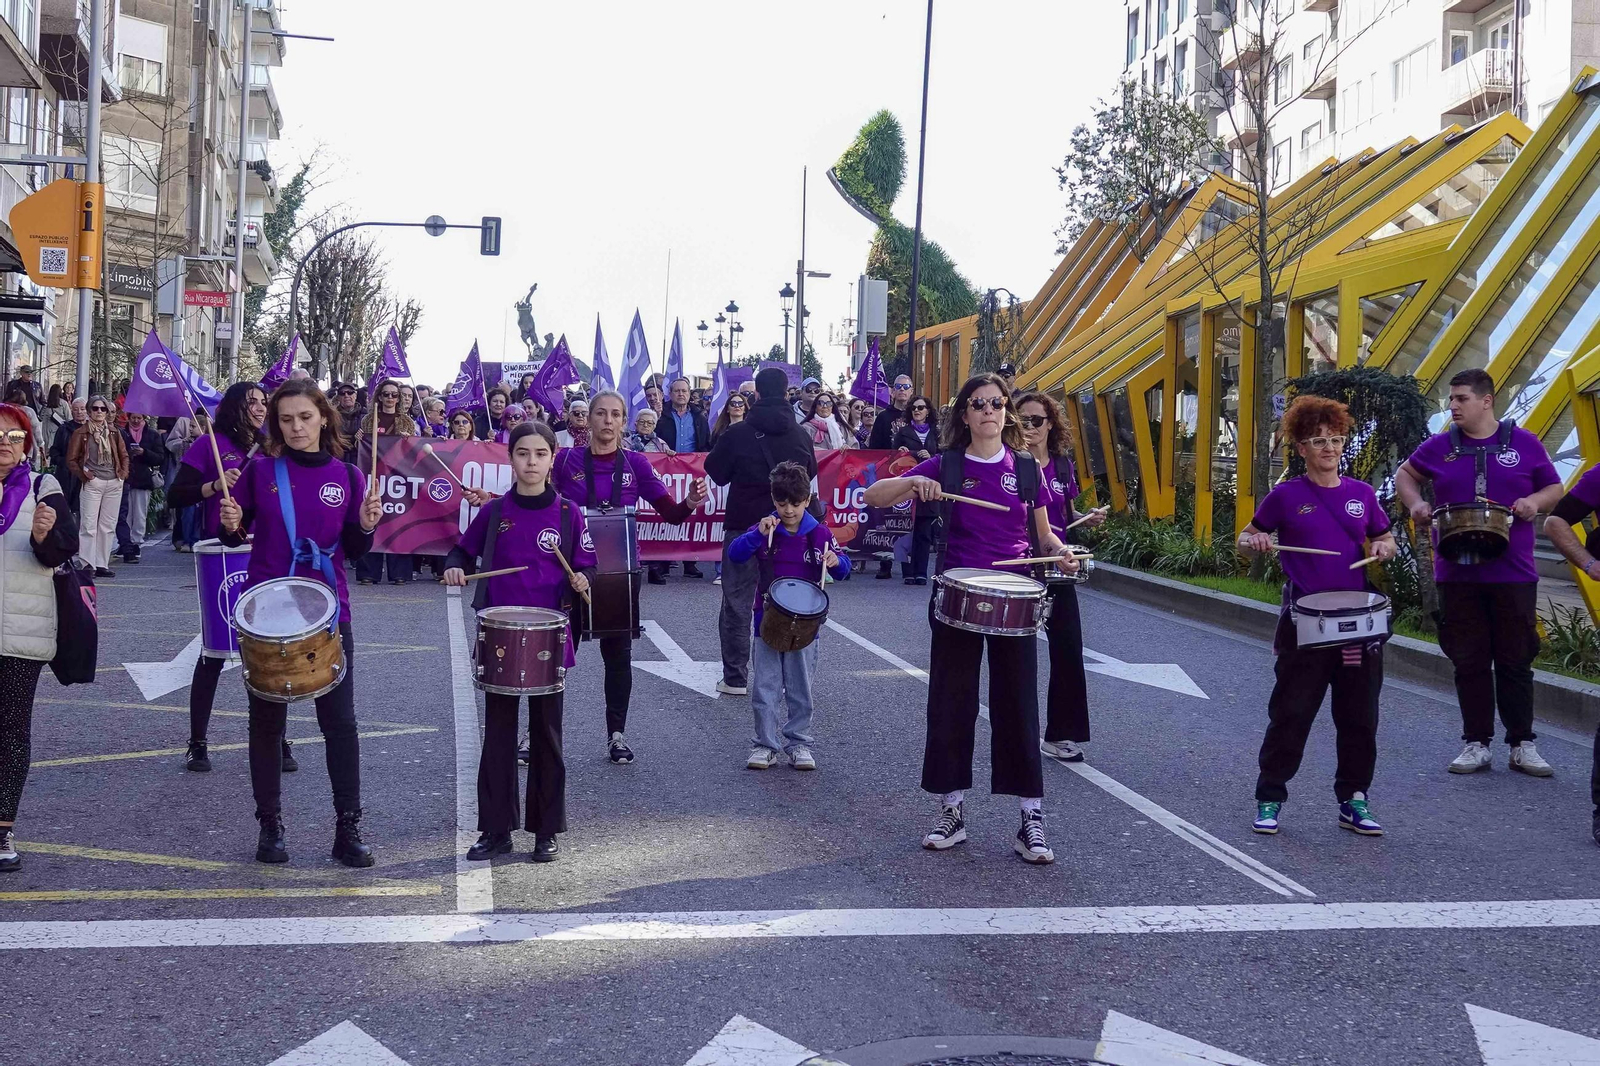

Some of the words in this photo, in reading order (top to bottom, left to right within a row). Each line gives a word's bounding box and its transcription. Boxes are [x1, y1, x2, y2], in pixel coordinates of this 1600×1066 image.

[184, 293, 196, 302] Rúa
[196, 293, 224, 306] Nicaragua
[323, 486, 342, 497] UGT
[367, 474, 425, 500] UGT
[833, 488, 879, 509] UG
[382, 503, 406, 514] GO
[832, 513, 869, 524] VIGO
[692, 522, 708, 542] DA
